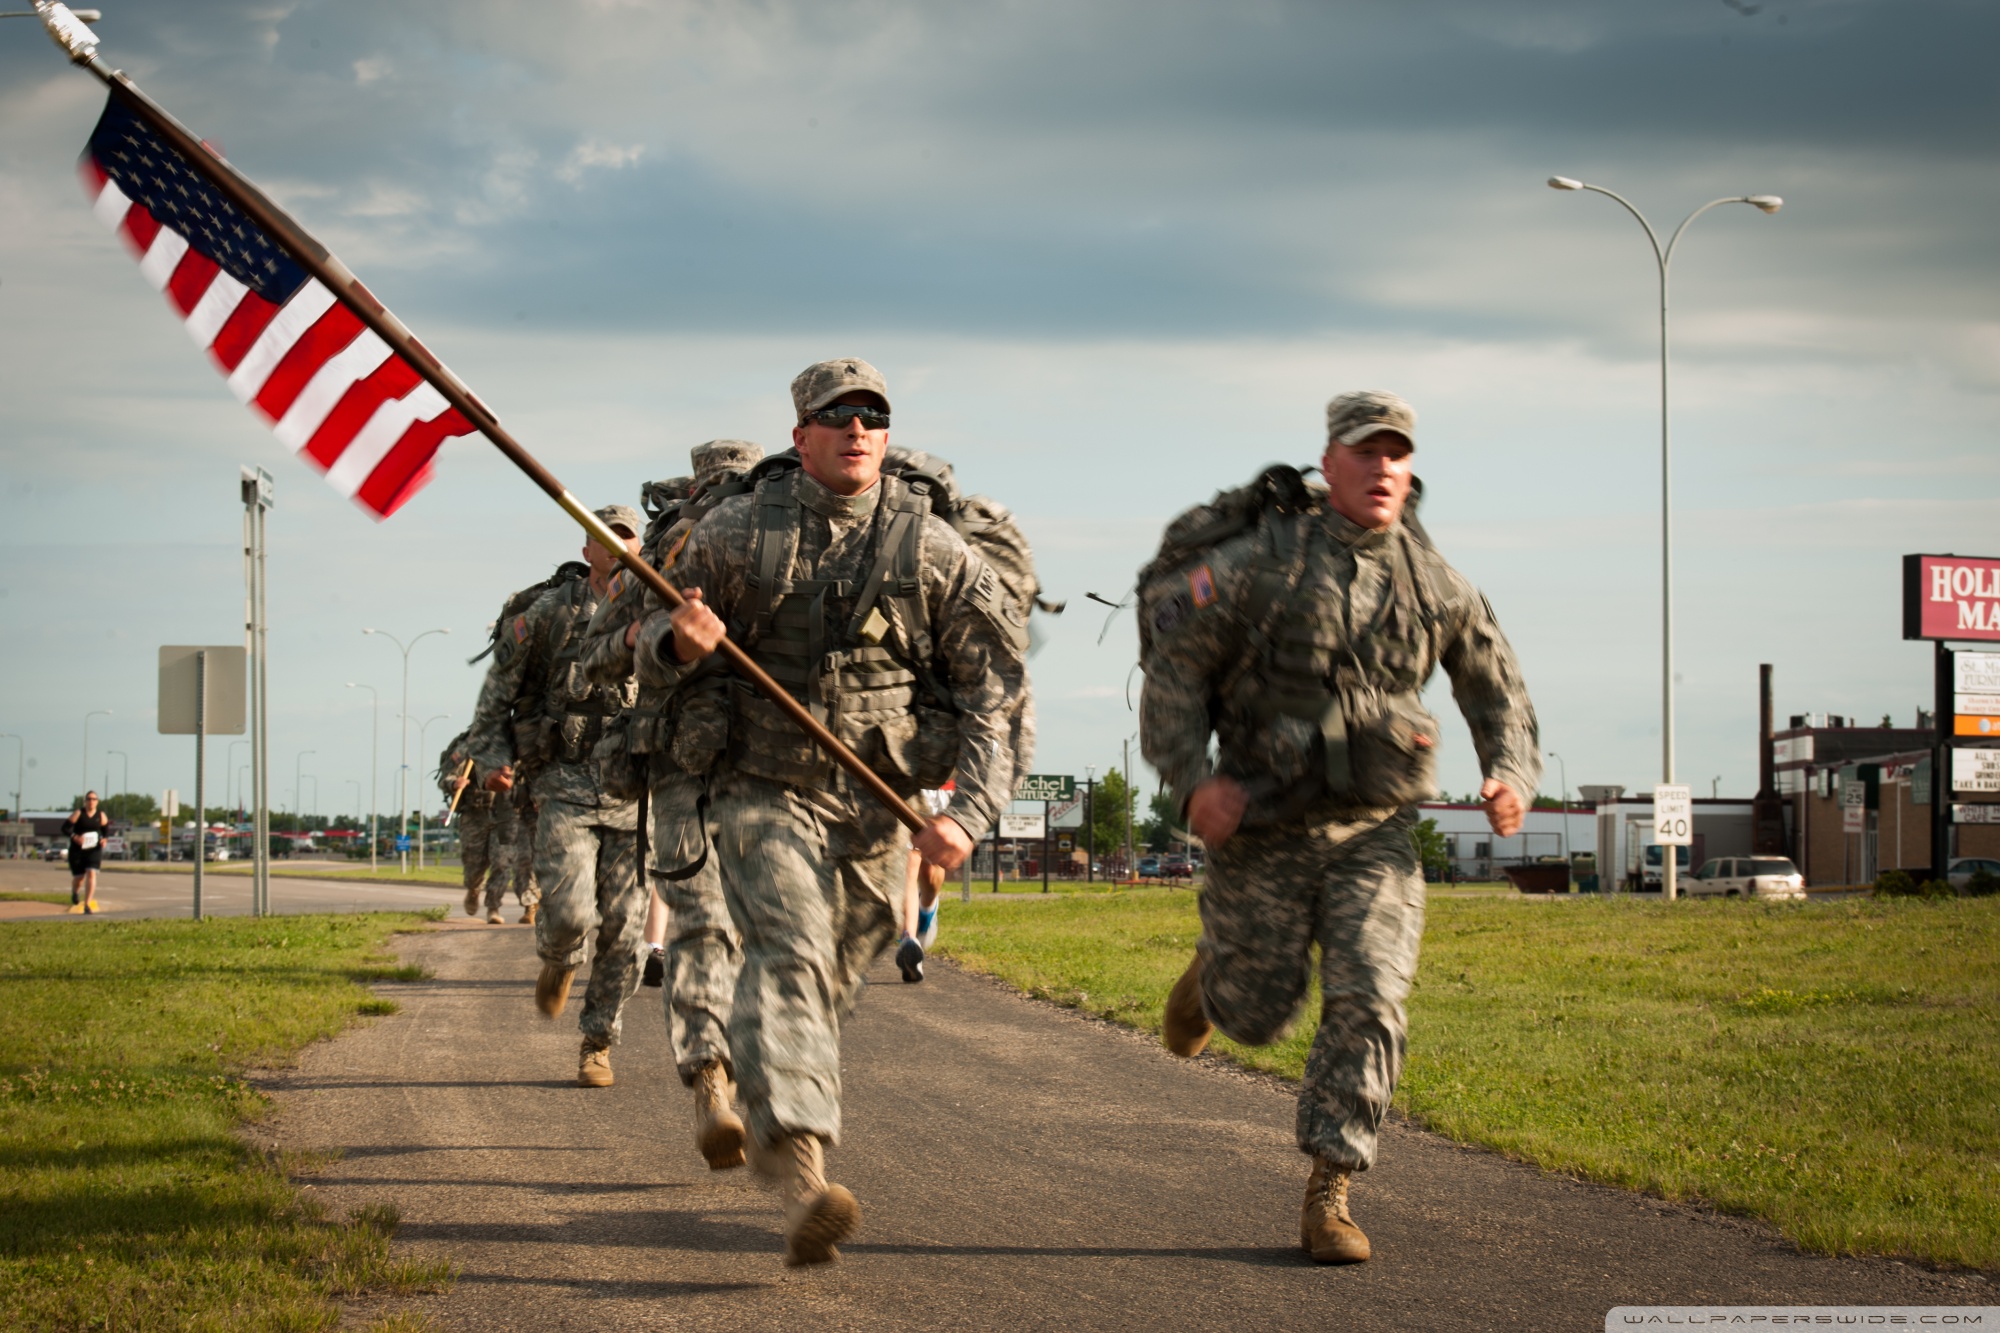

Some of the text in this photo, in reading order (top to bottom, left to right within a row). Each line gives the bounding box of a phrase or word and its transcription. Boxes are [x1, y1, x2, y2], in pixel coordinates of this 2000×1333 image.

[979, 567, 997, 596] MP
[1956, 600, 2000, 630] MA
[1975, 752, 1988, 760] ALL
[1954, 780, 1973, 789] TAKE
[1658, 791, 1688, 800] SPEED
[1846, 793, 1863, 804] 25
[1661, 804, 1685, 814] LIMIT
[1959, 805, 1988, 814] WHITE
[1964, 813, 1988, 822] CAFE
[1659, 819, 1687, 837] 40
